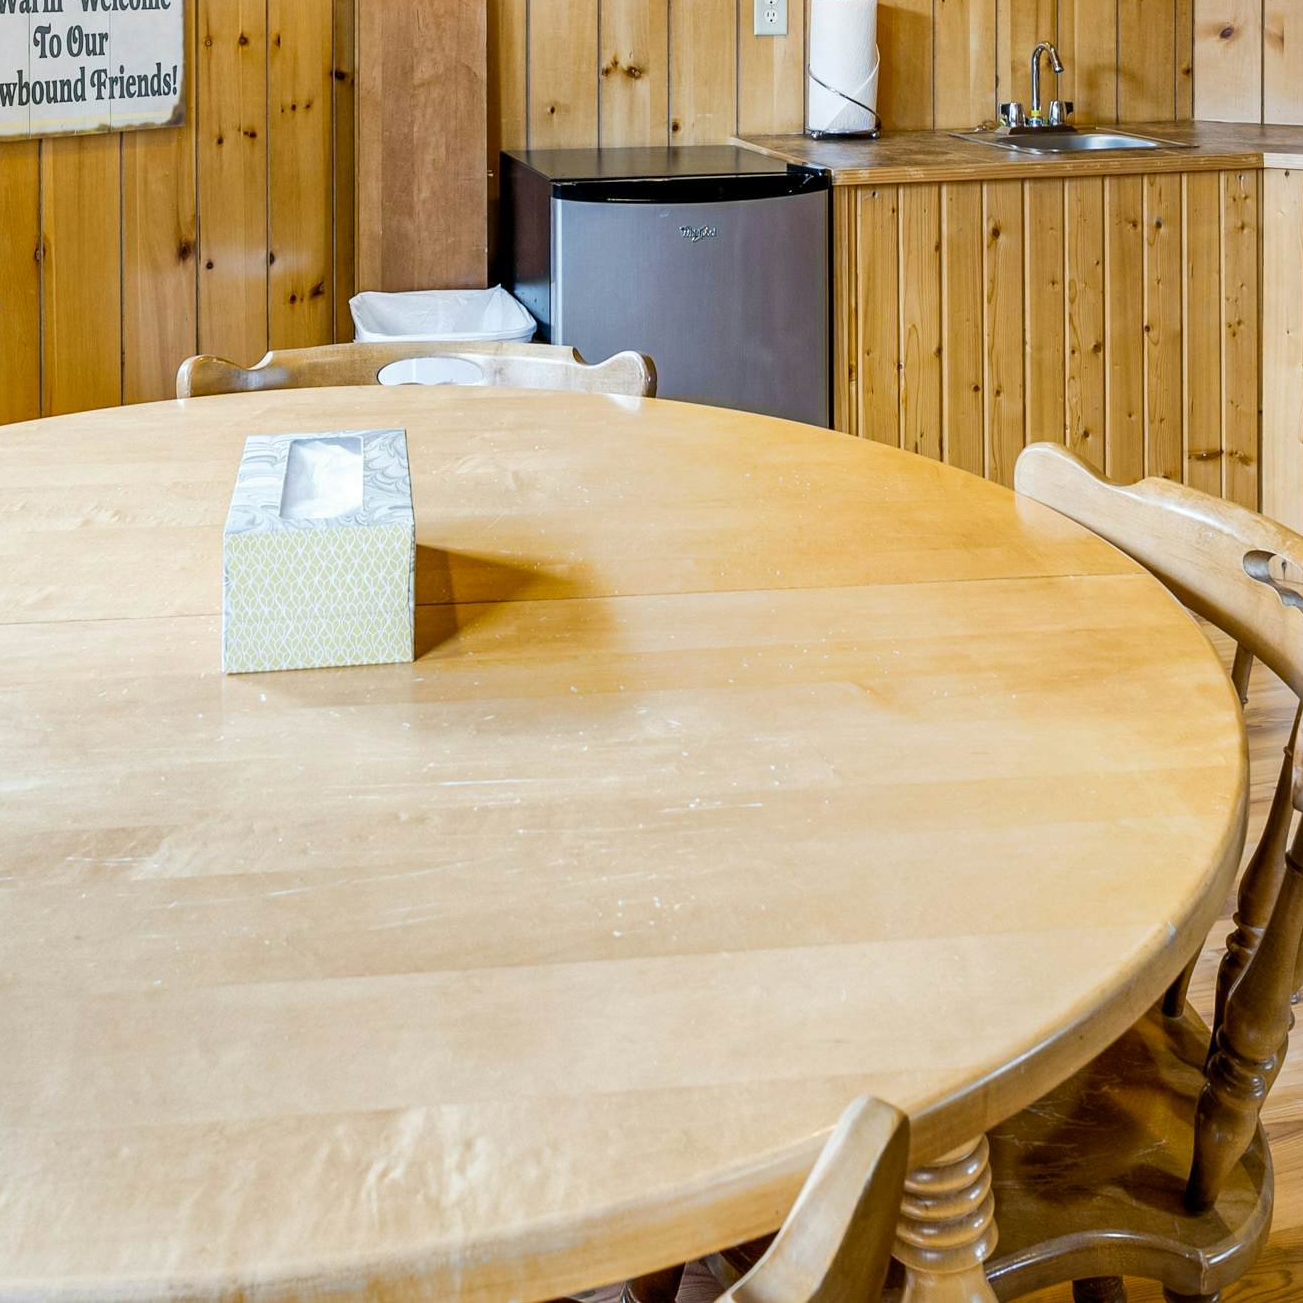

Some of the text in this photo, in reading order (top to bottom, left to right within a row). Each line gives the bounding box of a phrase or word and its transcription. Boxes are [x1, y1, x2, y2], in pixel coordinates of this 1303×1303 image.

[33, 23, 108, 59] To Our
[90, 62, 178, 101] Friends!
